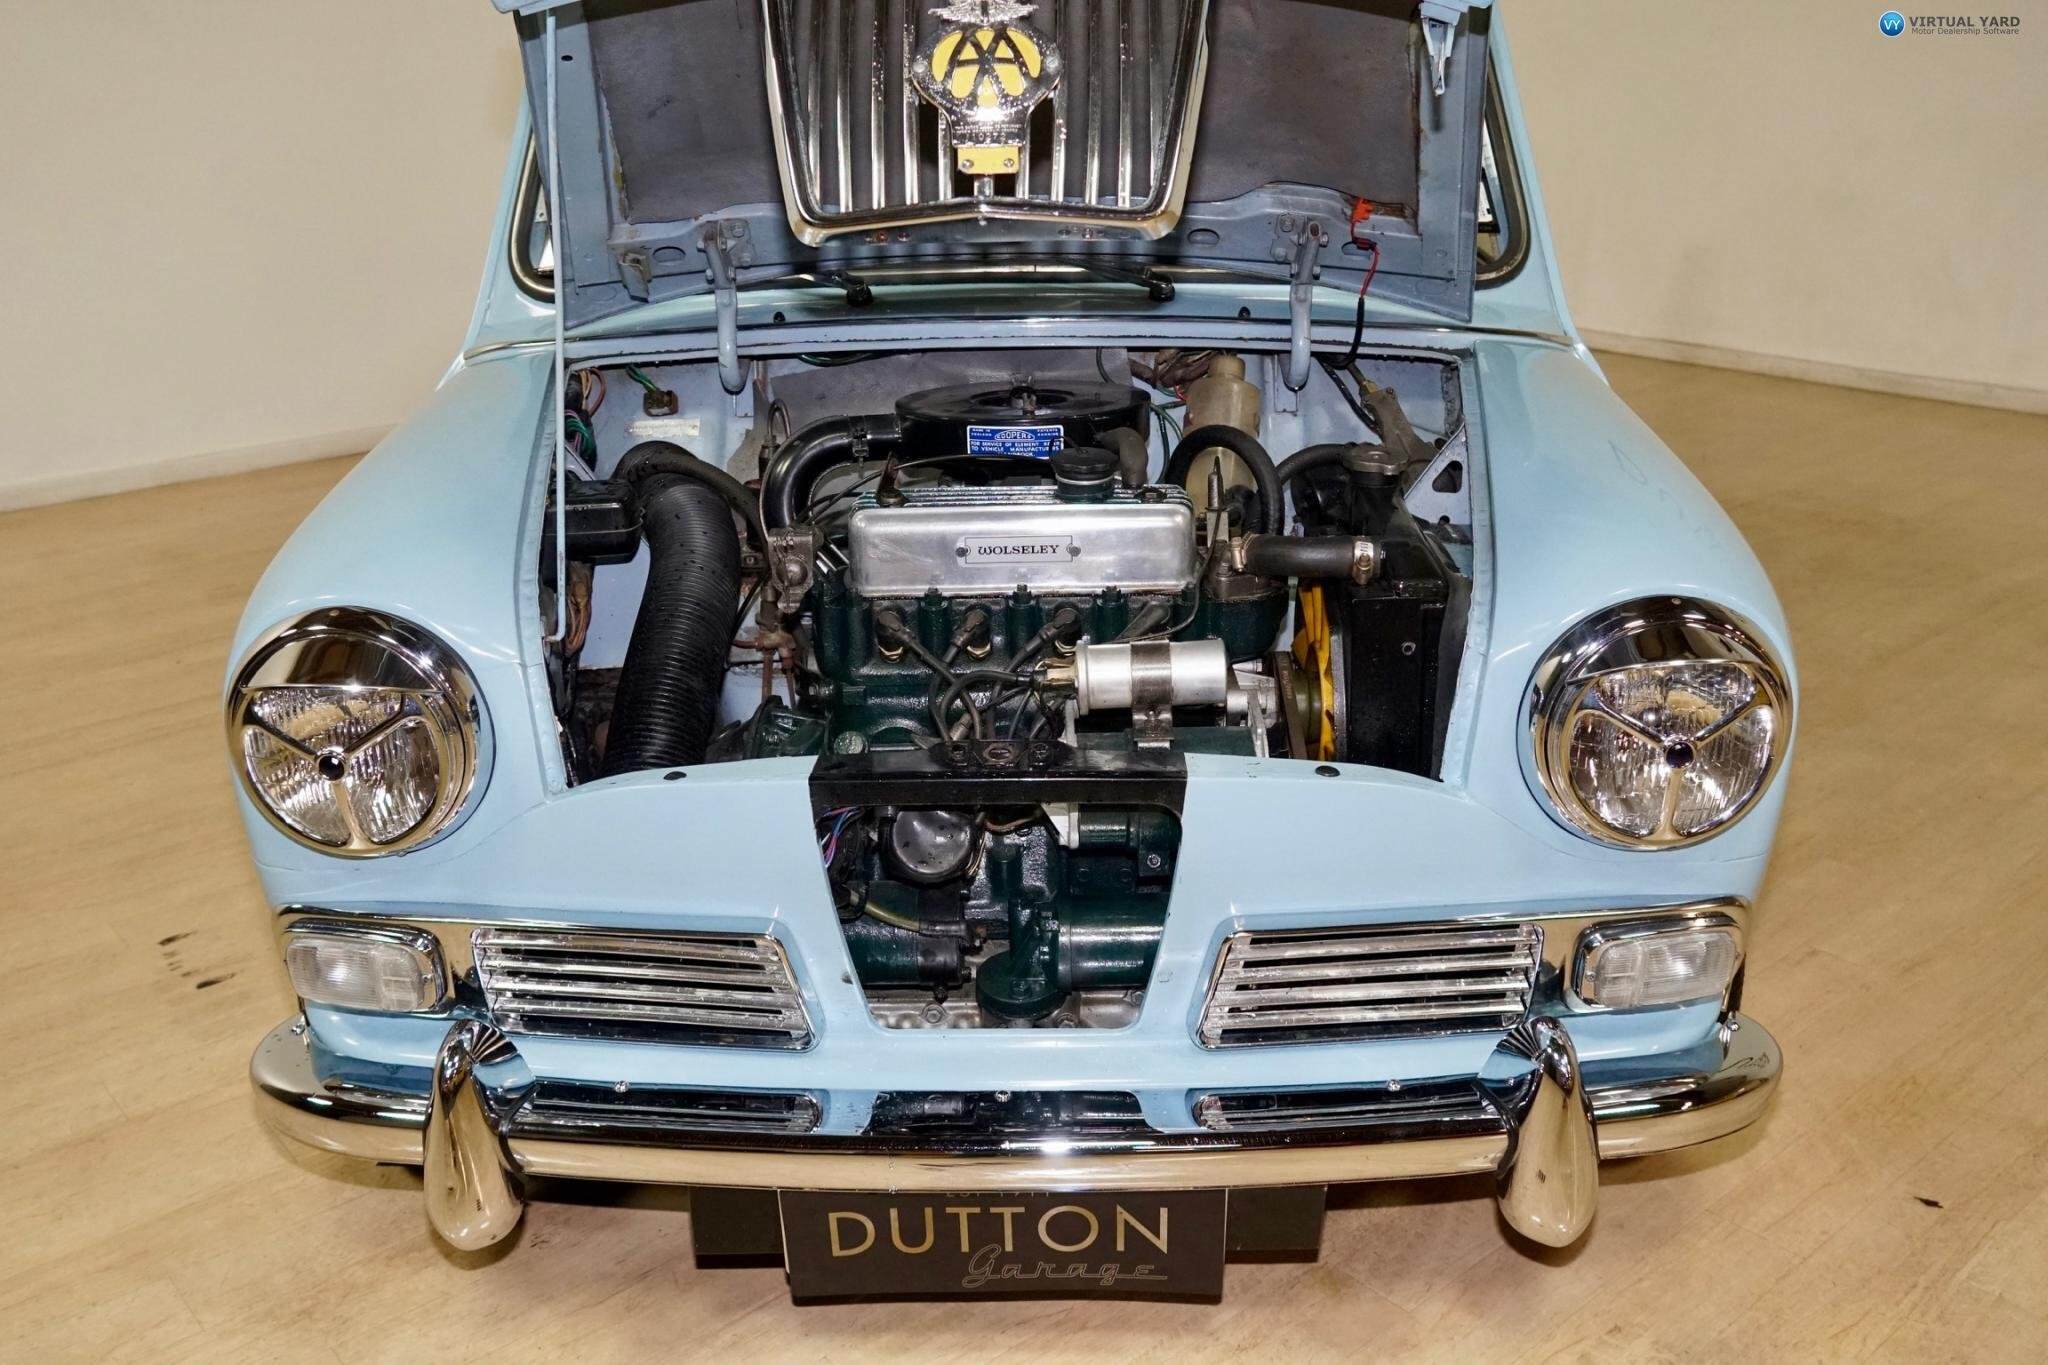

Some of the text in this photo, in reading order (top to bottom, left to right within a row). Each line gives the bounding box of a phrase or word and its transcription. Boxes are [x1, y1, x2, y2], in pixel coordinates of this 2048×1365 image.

[996, 431, 1032, 440] COOPERS
[978, 544, 1060, 555] WOLSELEY
[828, 1204, 1168, 1257] DUTTON
[962, 1243, 1168, 1288] Garage
